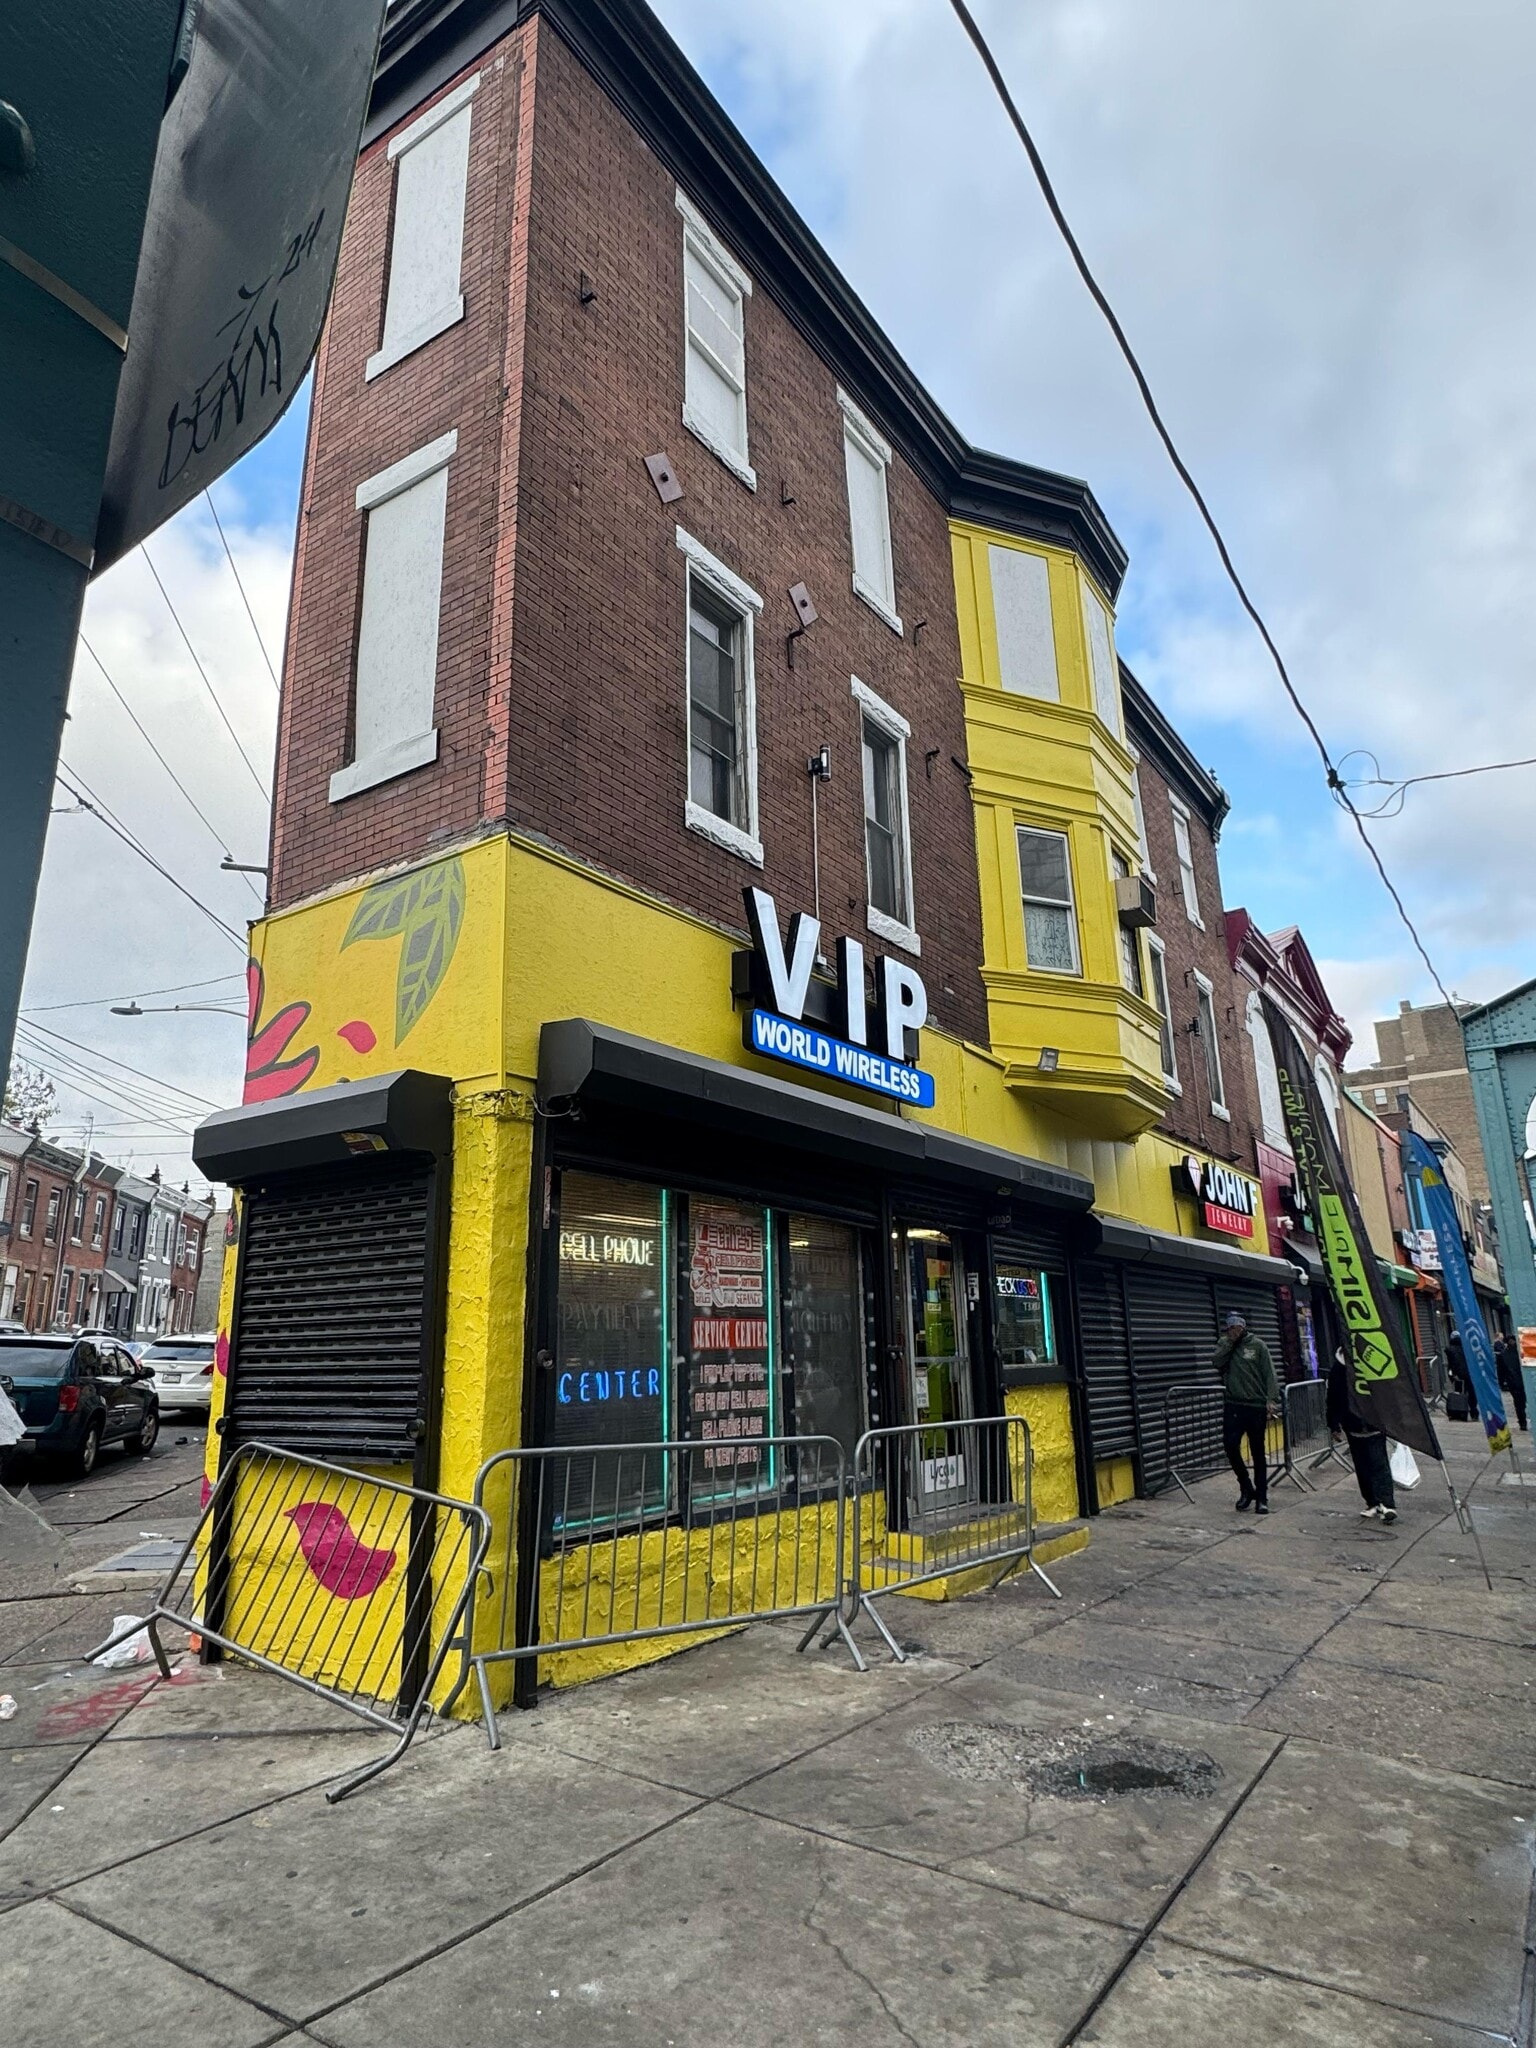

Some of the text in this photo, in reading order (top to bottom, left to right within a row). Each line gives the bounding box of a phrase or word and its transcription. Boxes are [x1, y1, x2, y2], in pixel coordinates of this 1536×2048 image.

[745, 886, 928, 1061] VIP
[755, 1014, 921, 1099] WORLD WIRELESS
[1205, 1162, 1258, 1217] JOHN F
[1211, 1207, 1248, 1232] JEWELRY
[559, 1232, 655, 1266] CELL PHONE
[693, 1320, 768, 1349] SERVICE CENTER
[558, 1368, 660, 1404] CENTER
[704, 1446, 735, 1469] PAMENT
